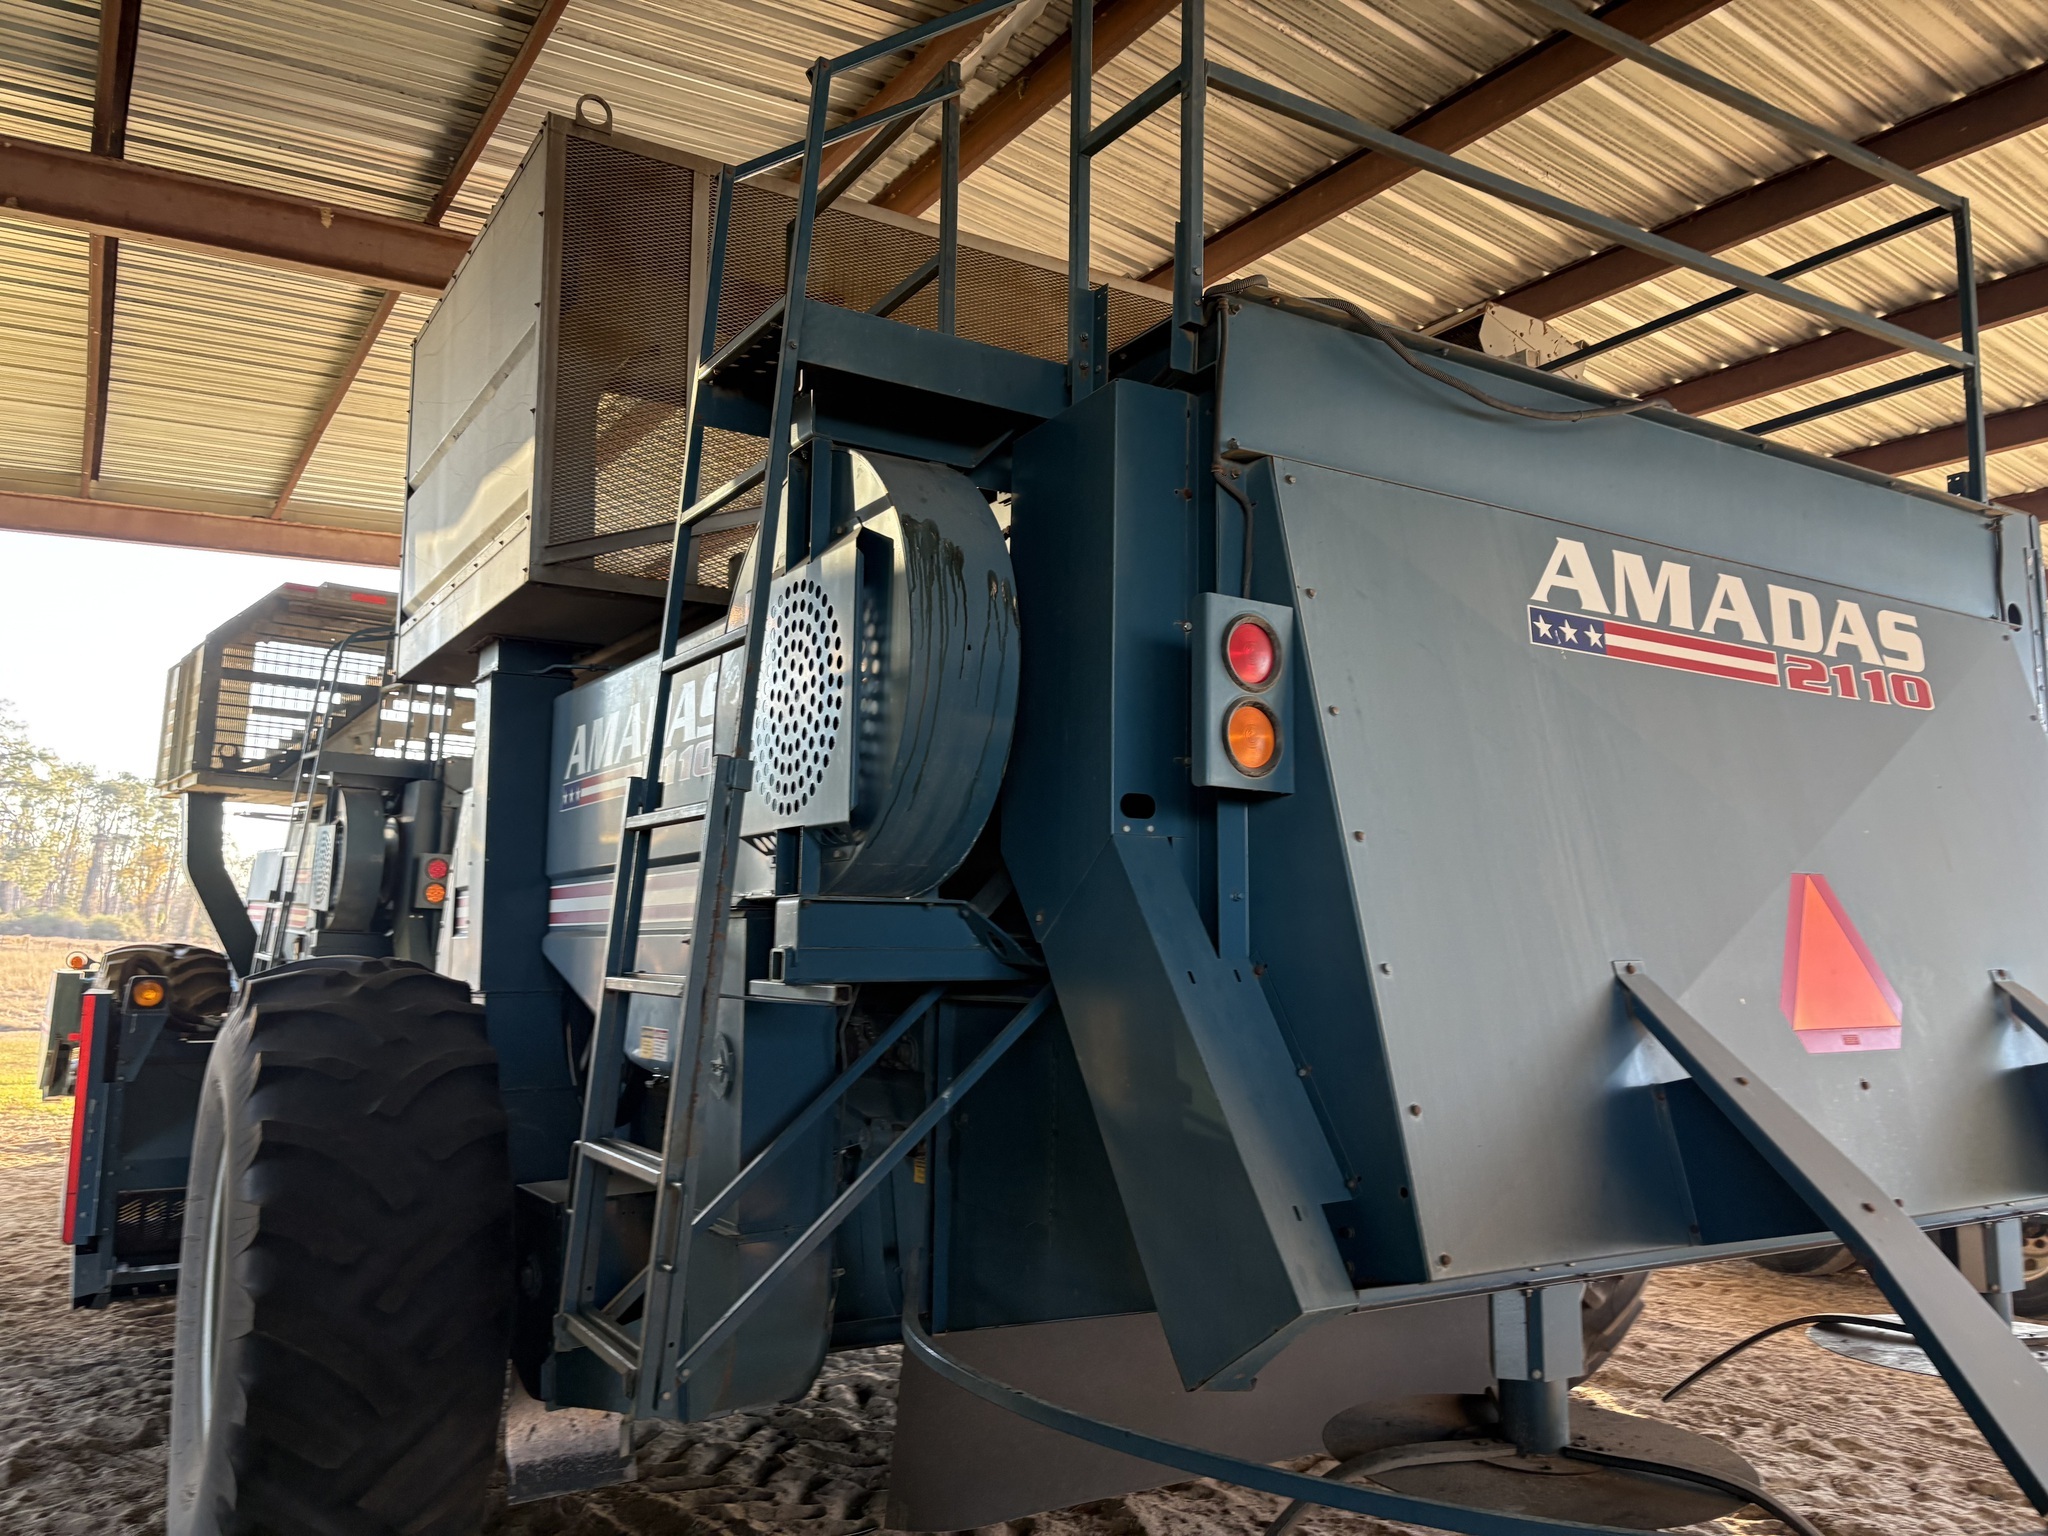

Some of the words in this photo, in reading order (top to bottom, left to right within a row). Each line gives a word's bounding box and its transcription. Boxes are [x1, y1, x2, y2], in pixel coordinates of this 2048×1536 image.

[1530, 537, 1926, 673] AMADAS
[1784, 654, 1936, 711] 2110
[663, 739, 713, 787] 110
